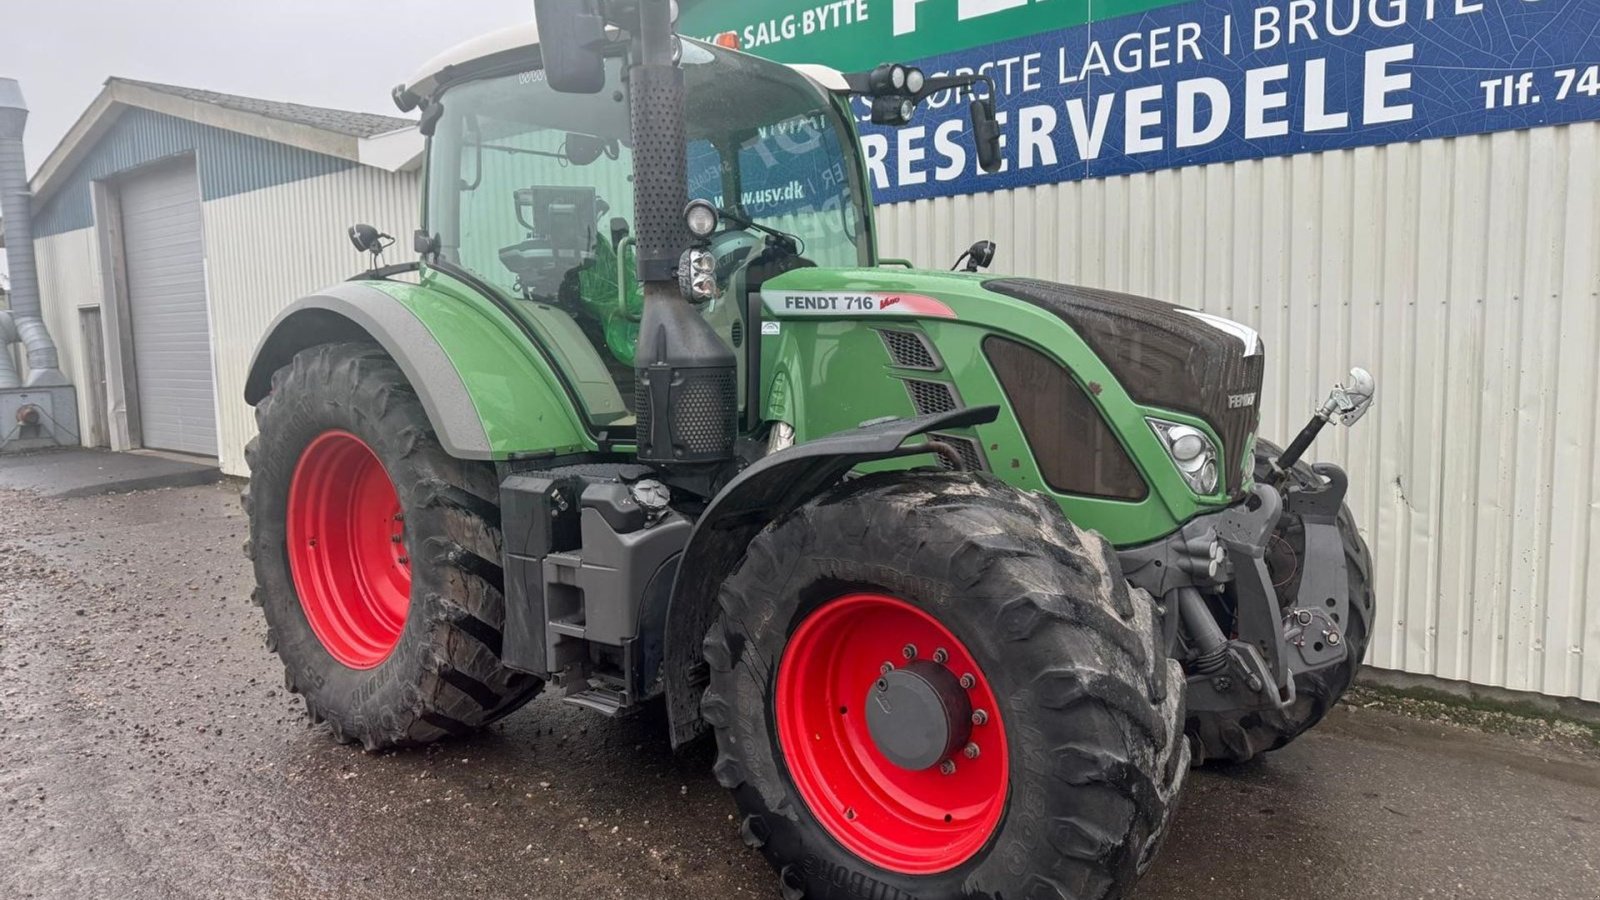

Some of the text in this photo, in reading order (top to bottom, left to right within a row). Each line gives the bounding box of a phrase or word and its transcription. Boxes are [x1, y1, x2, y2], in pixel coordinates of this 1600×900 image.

[1058, 22, 1204, 85] LAGER
[1223, 14, 1232, 56] I
[1480, 65, 1600, 110] Tlf. 74
[714, 180, 804, 208] ww.usv.dk
[785, 296, 838, 309] FENDT
[844, 296, 873, 310] 716
